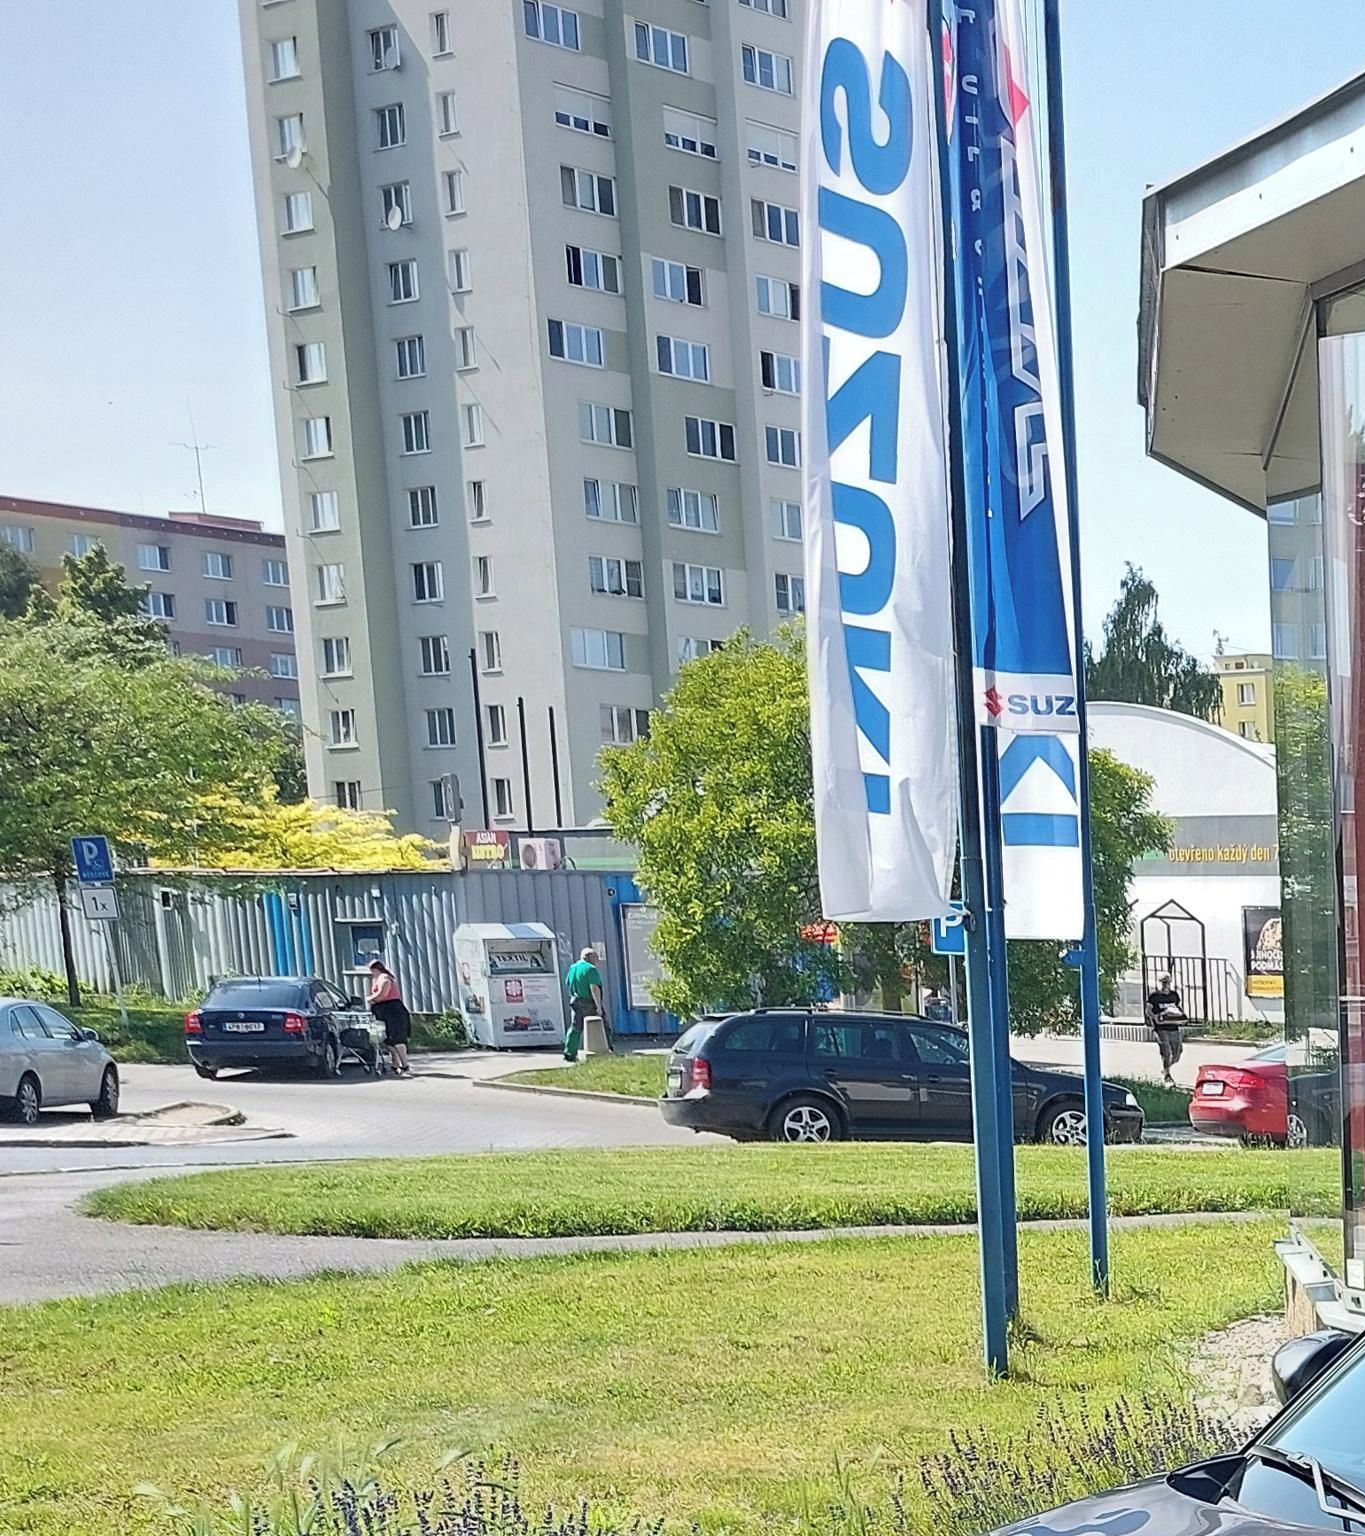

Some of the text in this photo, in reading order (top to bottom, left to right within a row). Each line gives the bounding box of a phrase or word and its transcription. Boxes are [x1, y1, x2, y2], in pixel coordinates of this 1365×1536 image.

[81, 841, 98, 866] P
[1168, 844, 1214, 863] otevřeno
[1217, 843, 1248, 864] každý
[1251, 843, 1270, 862] den
[91, 896, 109, 912] 1x
[940, 913, 963, 938] P
